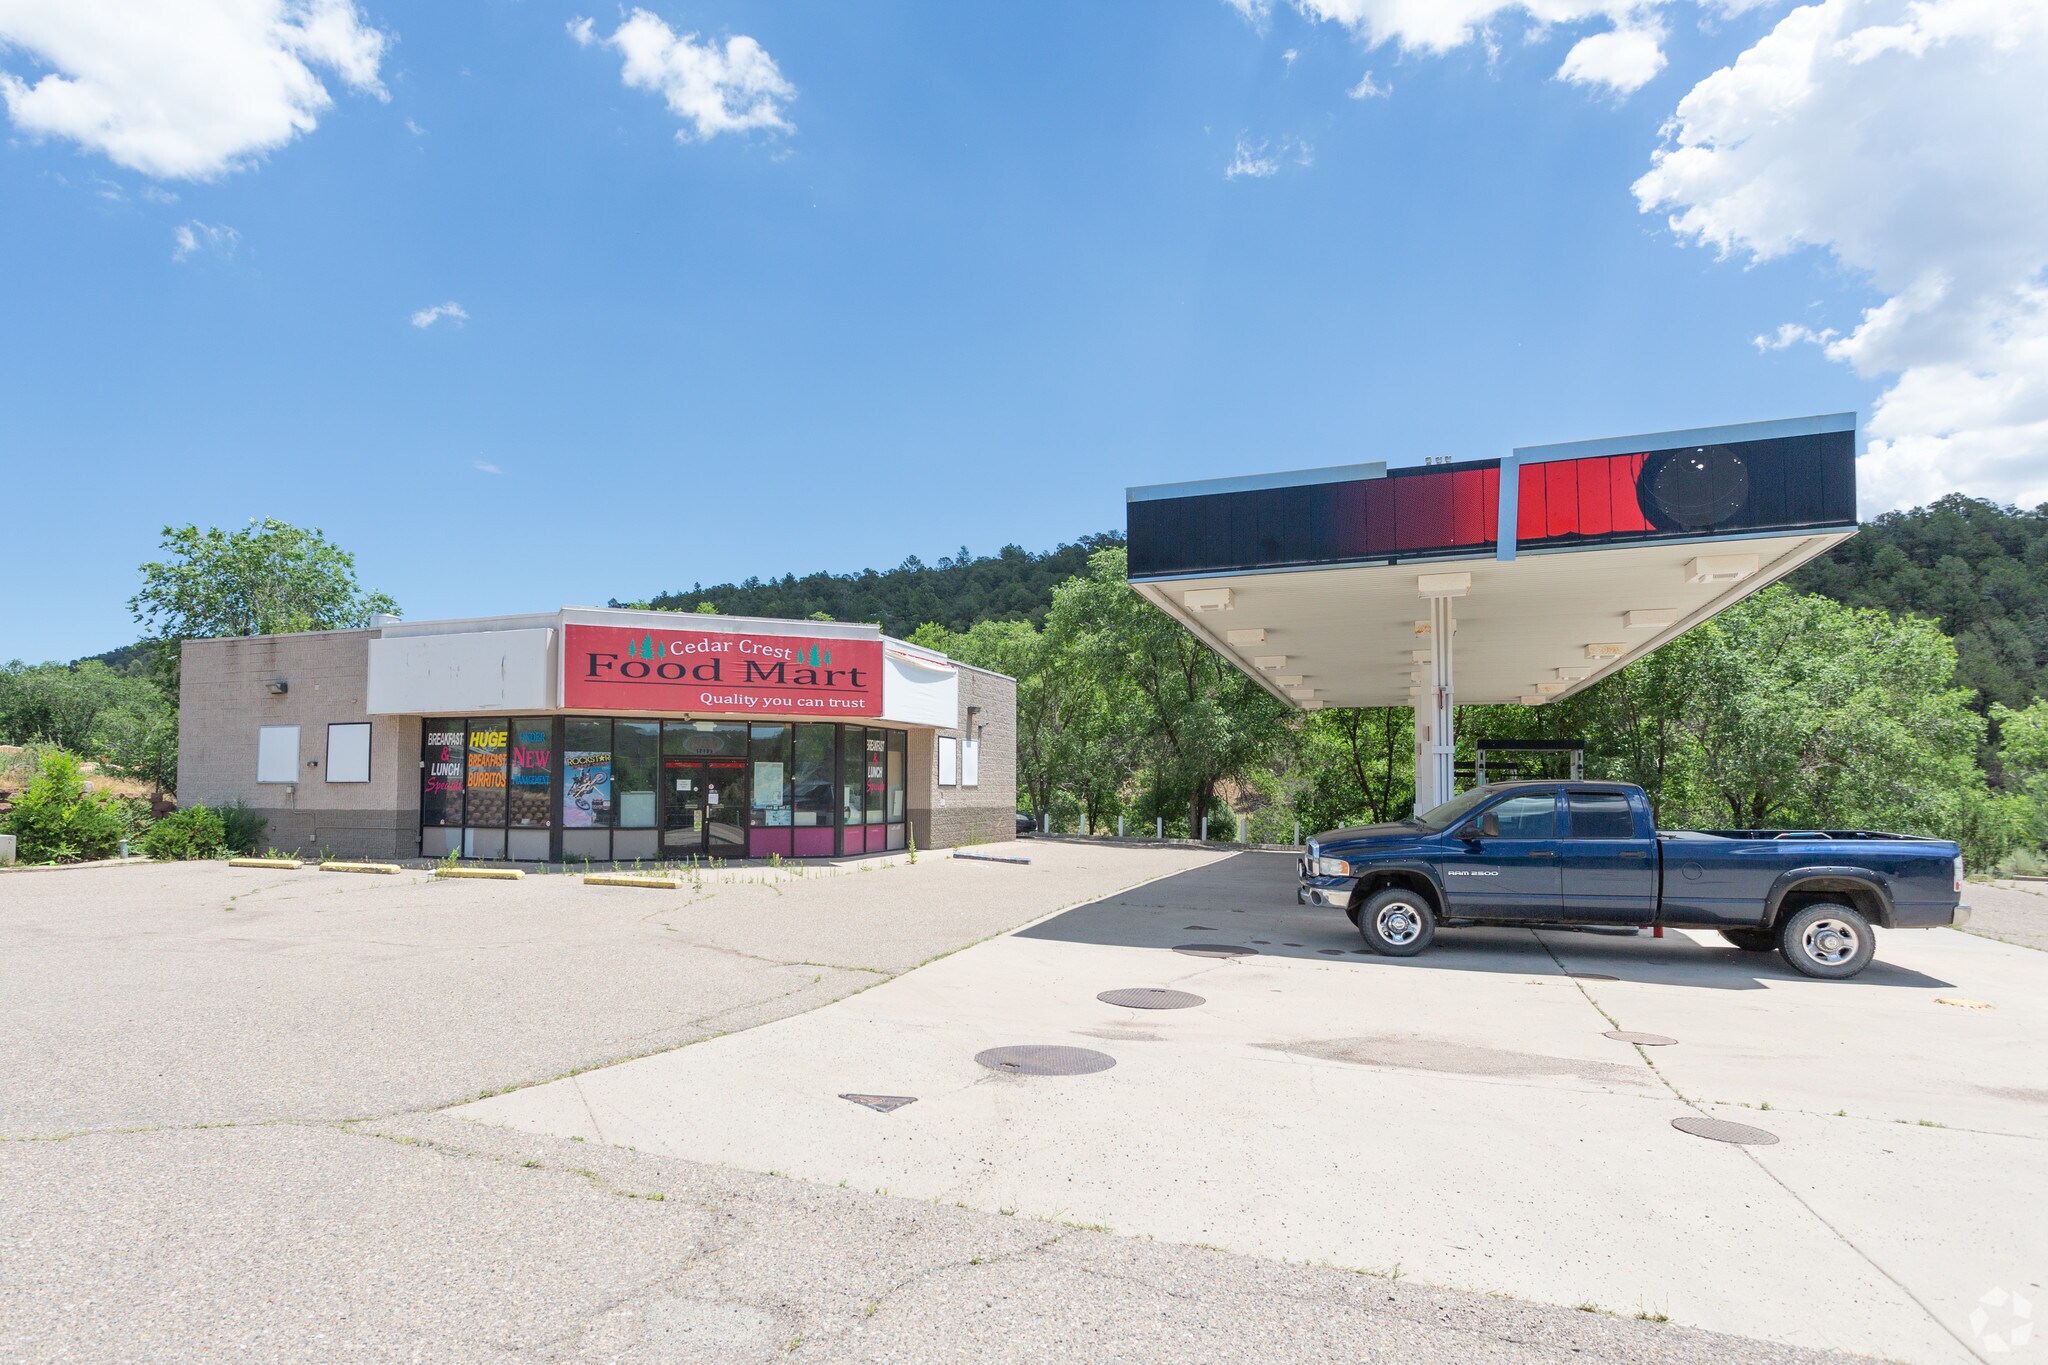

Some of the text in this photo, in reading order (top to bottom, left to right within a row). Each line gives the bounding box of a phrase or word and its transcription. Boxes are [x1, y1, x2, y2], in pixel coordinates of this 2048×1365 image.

[670, 638, 793, 660] Cedar Crest
[586, 652, 867, 687] Food Mart
[700, 692, 865, 708] Quality you can trust
[428, 732, 464, 745] BREAKFAST
[470, 732, 508, 747] HUGE
[519, 732, 545, 742] UNDER
[441, 747, 450, 762] &
[468, 753, 507, 767] BREAKFAST
[513, 747, 551, 768] NEW
[431, 763, 460, 776] LUNCH
[867, 766, 883, 778] LUNCH
[425, 777, 462, 794] Specials
[467, 771, 507, 787] BURRITOS
[512, 775, 550, 785] MANAGEMENT
